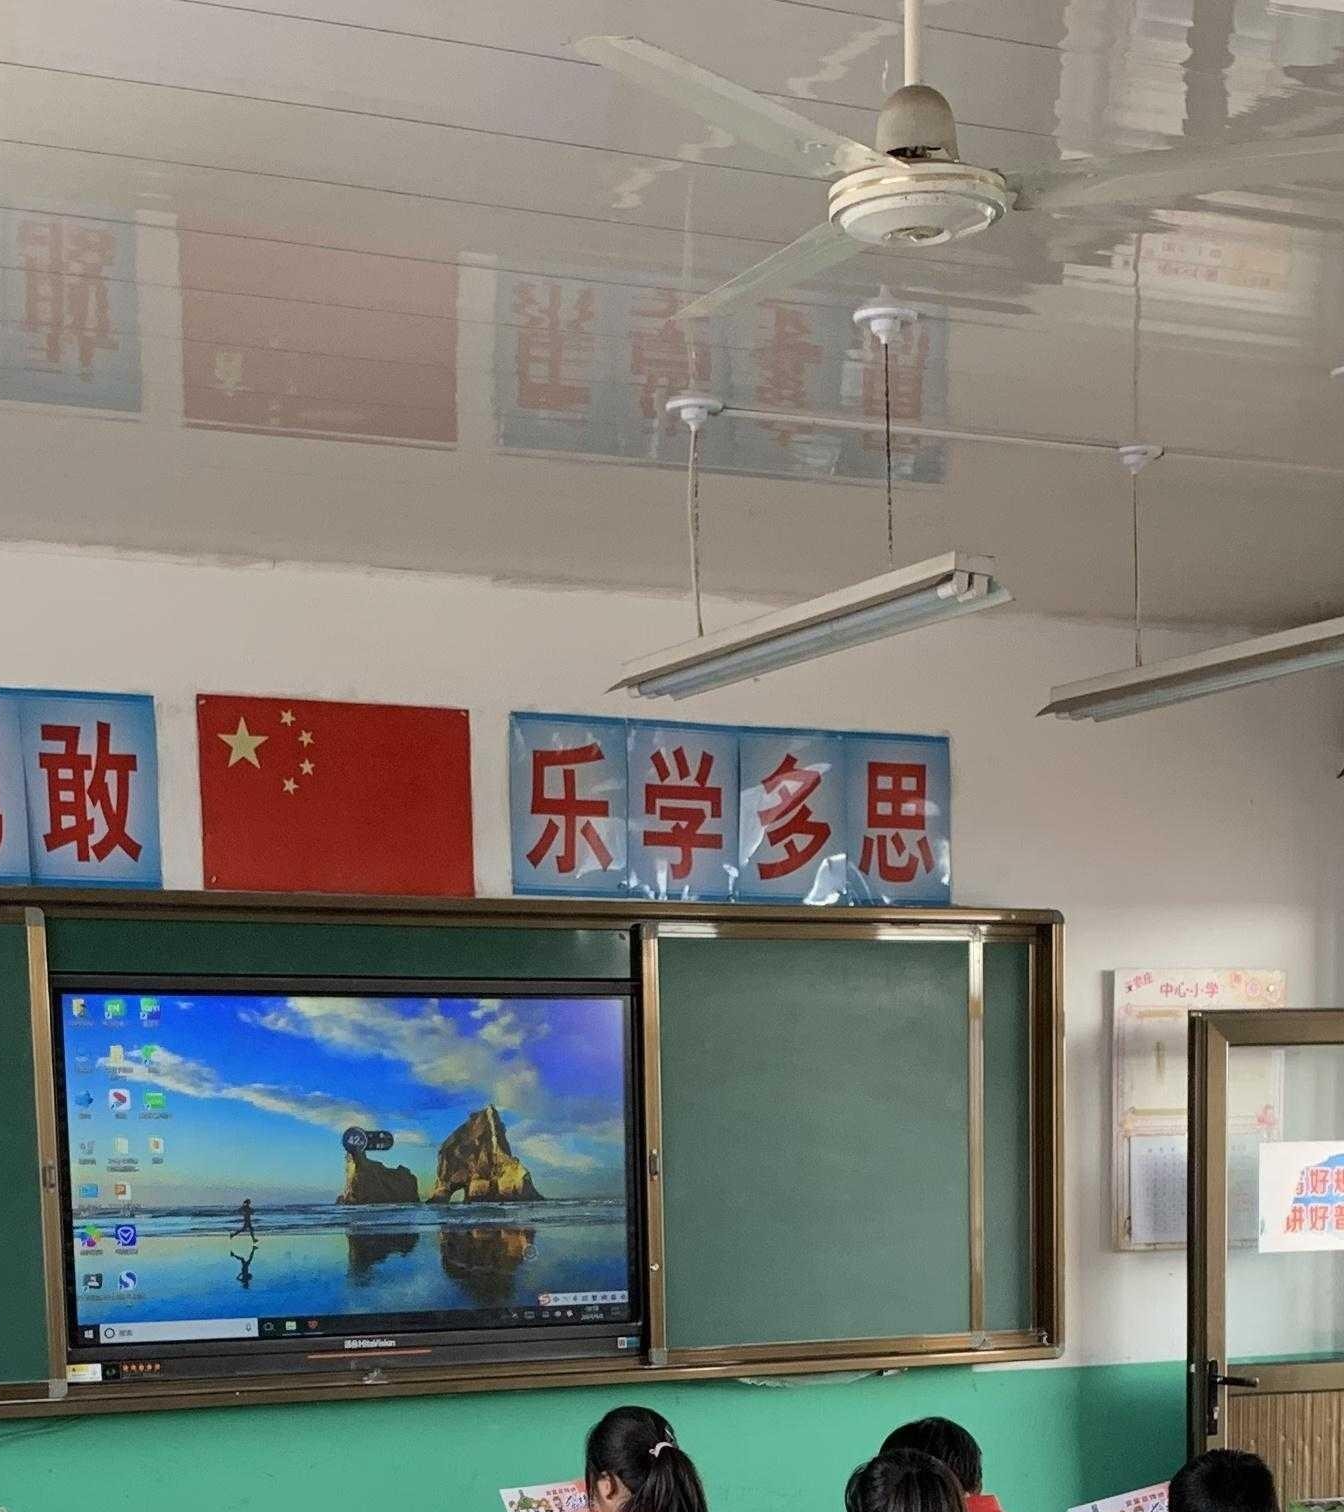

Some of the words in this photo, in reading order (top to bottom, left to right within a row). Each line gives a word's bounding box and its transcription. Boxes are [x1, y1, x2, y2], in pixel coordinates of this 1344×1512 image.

[527, 741, 937, 885] 乐学多思
[1159, 981, 1219, 998] 中心小学
